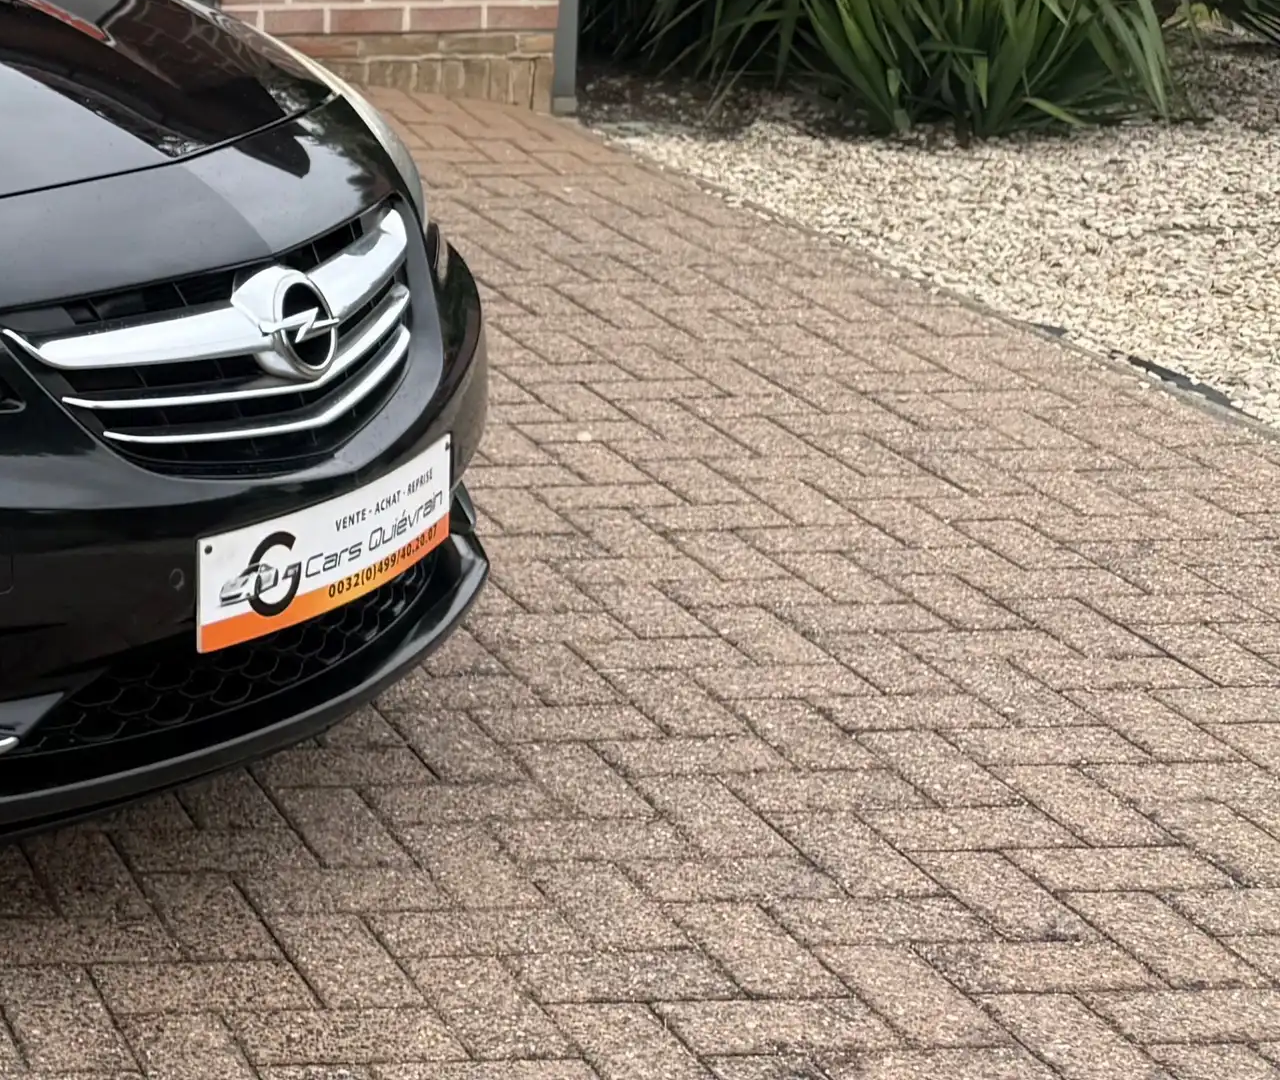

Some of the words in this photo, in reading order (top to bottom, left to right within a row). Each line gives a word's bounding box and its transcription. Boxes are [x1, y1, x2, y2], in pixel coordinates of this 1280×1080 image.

[305, 541, 363, 578] Cars
[368, 489, 443, 552] Quiévrain
[335, 508, 367, 532] VENTE
[374, 490, 402, 515] ACHAT
[406, 467, 434, 497] REPRISE
[328, 523, 438, 598] 0032(0)499/40.20.07
